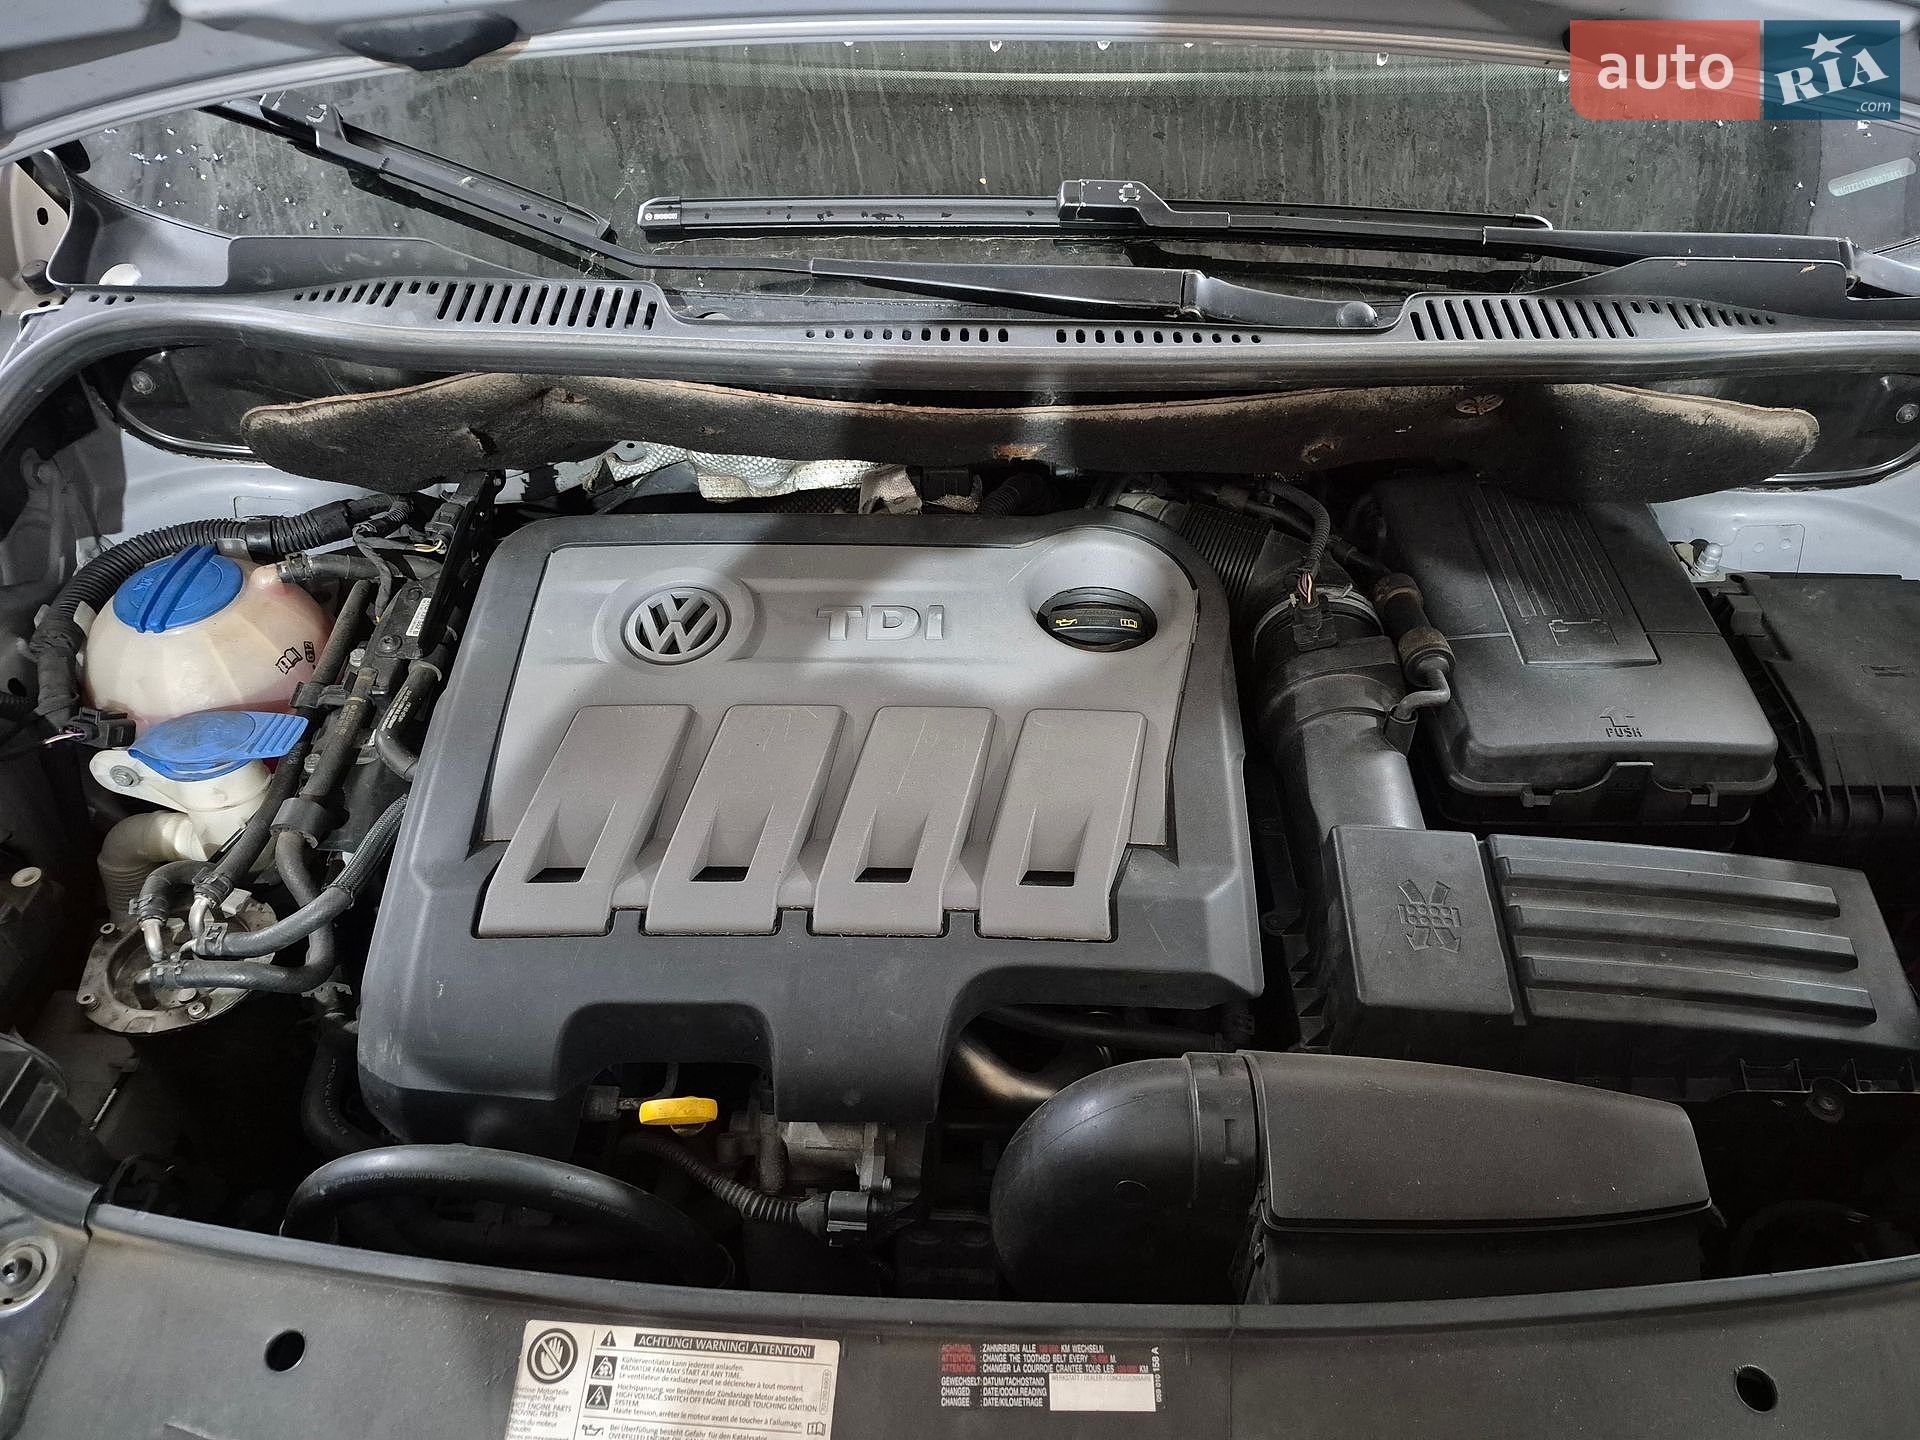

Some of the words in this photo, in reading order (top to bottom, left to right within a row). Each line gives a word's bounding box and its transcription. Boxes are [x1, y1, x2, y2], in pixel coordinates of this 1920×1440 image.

[624, 588, 728, 662] VW
[816, 604, 946, 641] TDI
[1605, 727, 1643, 738] PUSH
[638, 1335, 693, 1349] ACHTUNG!
[696, 1338, 749, 1353] WARNING!
[751, 1342, 812, 1357] ATTENTION!
[1021, 1343, 1037, 1353] ALLE
[1060, 1344, 1071, 1353] KM
[1072, 1344, 1104, 1353] WECHSELN
[1151, 1346, 1160, 1355] A
[1008, 1353, 1021, 1363] THE
[1022, 1354, 1051, 1363] TOOTHED
[1052, 1354, 1067, 1363] BELT
[1068, 1354, 1089, 1363] EVERY
[621, 1365, 652, 1373] RADIATOR
[682, 1368, 700, 1376] START
[710, 1370, 723, 1378] ANY
[1013, 1364, 1021, 1373] LA
[1022, 1364, 1054, 1373] COURROIE
[1055, 1364, 1083, 1373] CRANTEE
[1084, 1364, 1101, 1373] TOUS
[1103, 1364, 1115, 1373] LES
[1139, 1365, 1149, 1373] KM
[670, 1376, 699, 1384] radiateur
[699, 1378, 713, 1386] peut
[754, 1393, 774, 1401] Motor
[941, 1387, 971, 1397] CHANGED
[616, 1391, 633, 1399] HIGH
[664, 1395, 689, 1403] SWITCH
[702, 1397, 726, 1405] ENGINE
[727, 1399, 751, 1407] BEFORE
[753, 1401, 787, 1410] TOUCHING
[787, 1404, 817, 1412] IGNITION
[941, 1397, 970, 1407] CHANGEE
[687, 1412, 711, 1420] moteur
[739, 1416, 763, 1424] toucher
[719, 1432, 732, 1440] den
